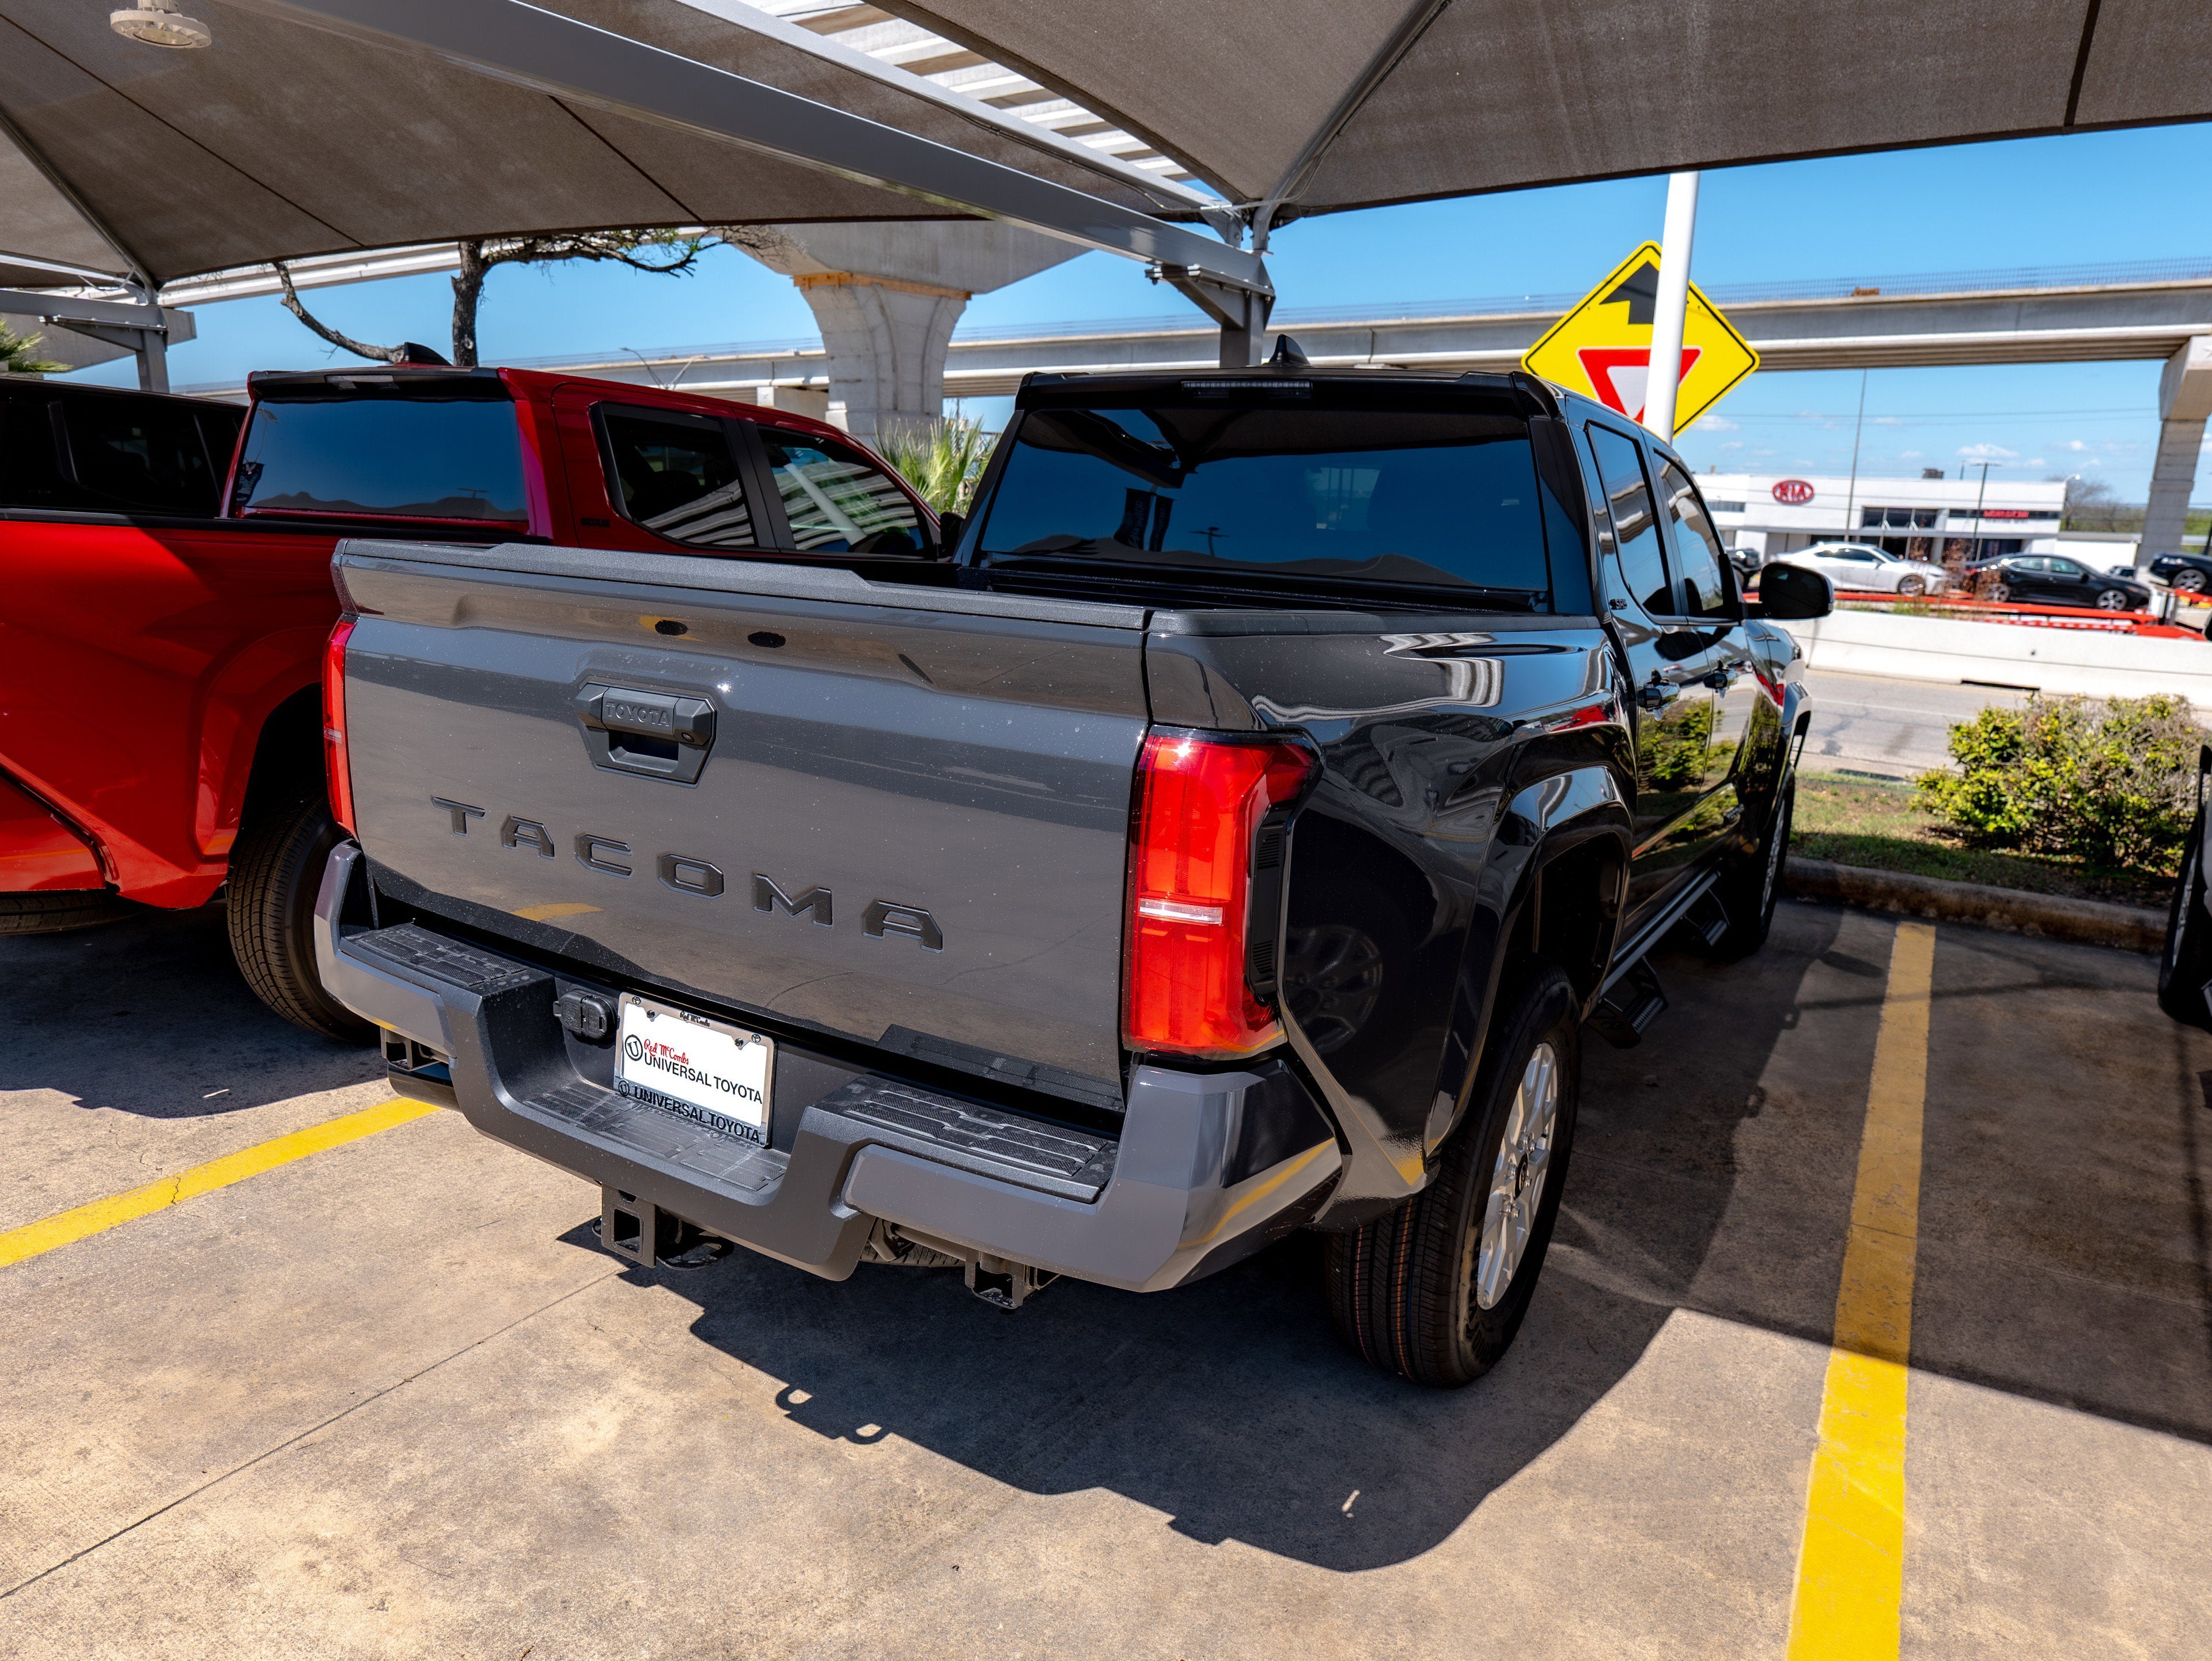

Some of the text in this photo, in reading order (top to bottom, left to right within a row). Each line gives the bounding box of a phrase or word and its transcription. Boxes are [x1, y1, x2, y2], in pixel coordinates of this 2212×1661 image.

[1778, 483, 1808, 503] KIA
[605, 701, 670, 727] TOYOTA
[431, 795, 943, 954] TACOMA
[643, 1039, 689, 1065] Red McCombs
[645, 1052, 763, 1104] UNIVERSAL TOYOTA
[634, 1085, 707, 1123] UNIVERSAL
[709, 1112, 760, 1144] TOYOTA
